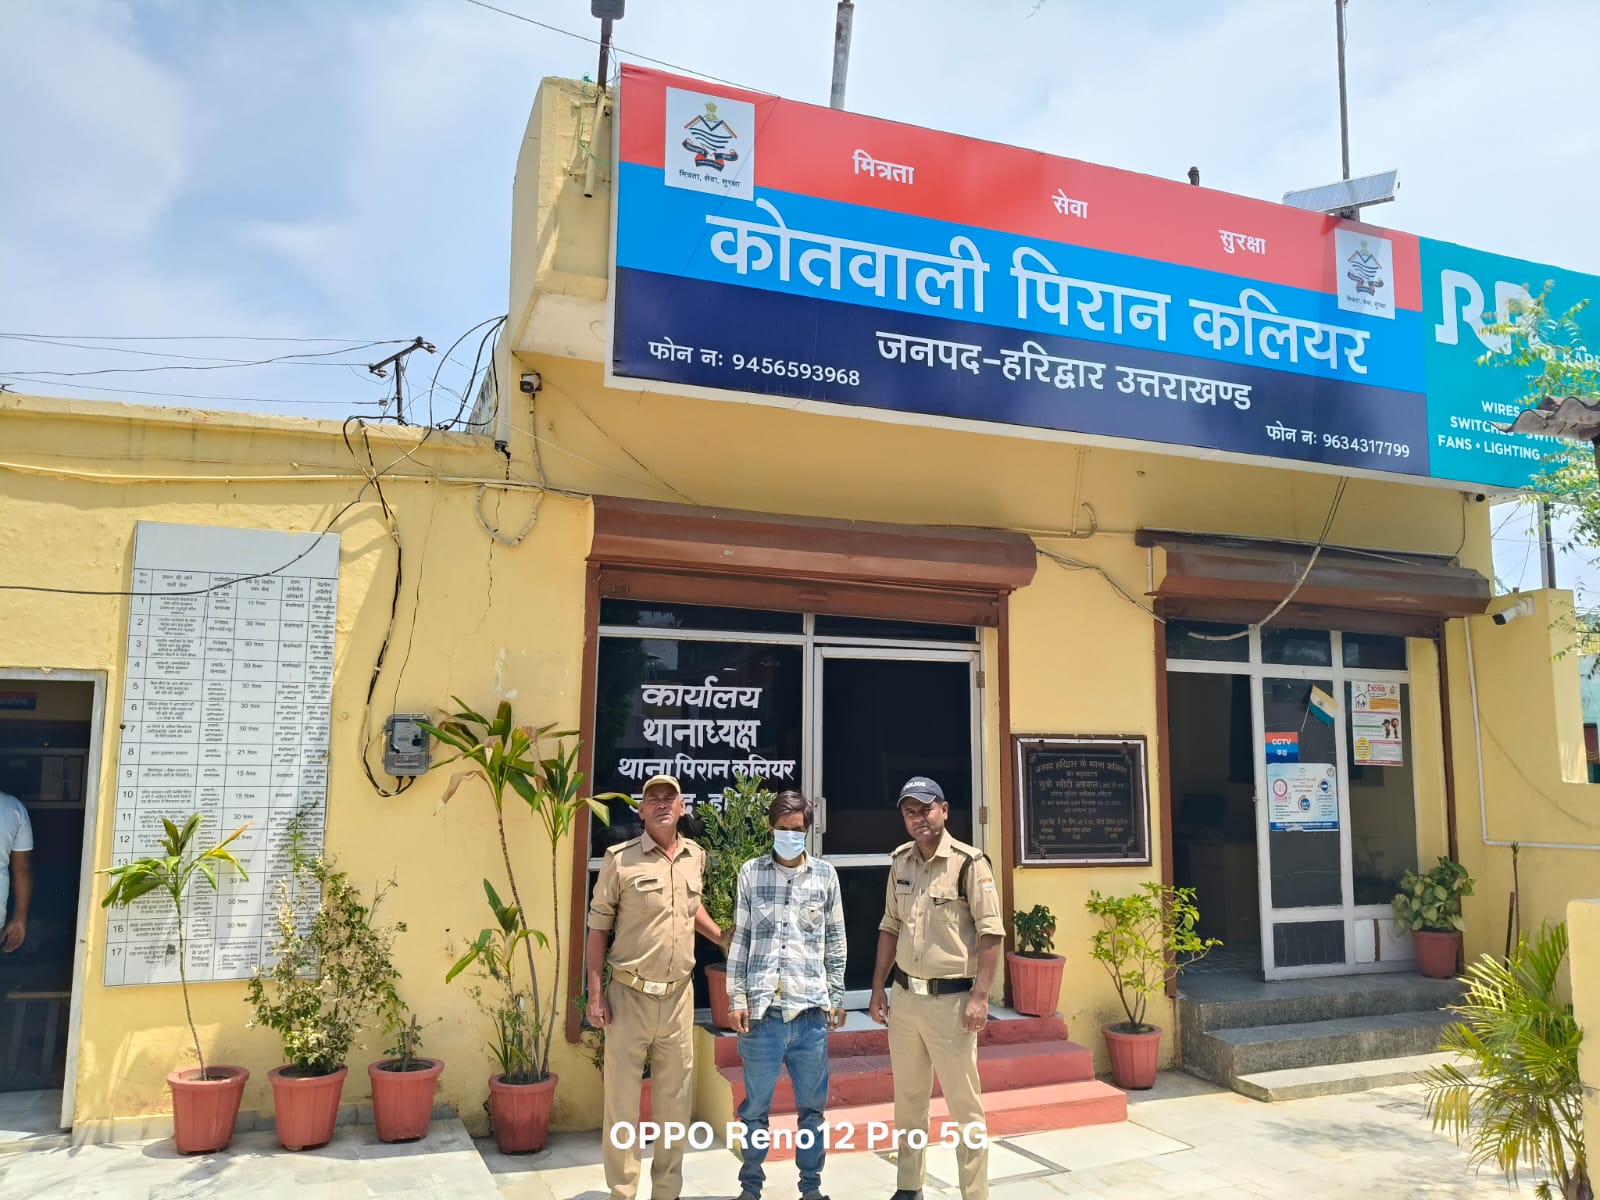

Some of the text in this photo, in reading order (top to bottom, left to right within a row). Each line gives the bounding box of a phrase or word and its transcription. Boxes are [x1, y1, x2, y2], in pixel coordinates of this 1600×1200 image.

[852, 149, 914, 185] मित्रता
[1052, 189, 1088, 219] सेवा
[1219, 229, 1266, 256] सुरक्षा
[706, 198, 1371, 375] कोतवाली पिरान कलियर
[648, 336, 693, 364] फोन
[732, 354, 861, 387] 9456593968
[1116, 364, 1253, 411] उत्तराखण्ड
[1481, 400, 1521, 418] WIRES
[1265, 420, 1297, 444] फोन
[1323, 433, 1411, 458] 9634317799
[1438, 434, 1473, 451] FANS
[1483, 441, 1541, 461] LIGHTING
[641, 675, 763, 709] कार्यालय
[642, 719, 761, 752] थानाध्यक्ष
[1271, 738, 1291, 746] CCTV
[618, 753, 796, 781] थाना पिरान कलियर
[122, 790, 134, 799] 10
[122, 813, 132, 821] 11
[119, 834, 130, 842] 12
[113, 925, 124, 933] 16
[112, 948, 122, 957] 17
